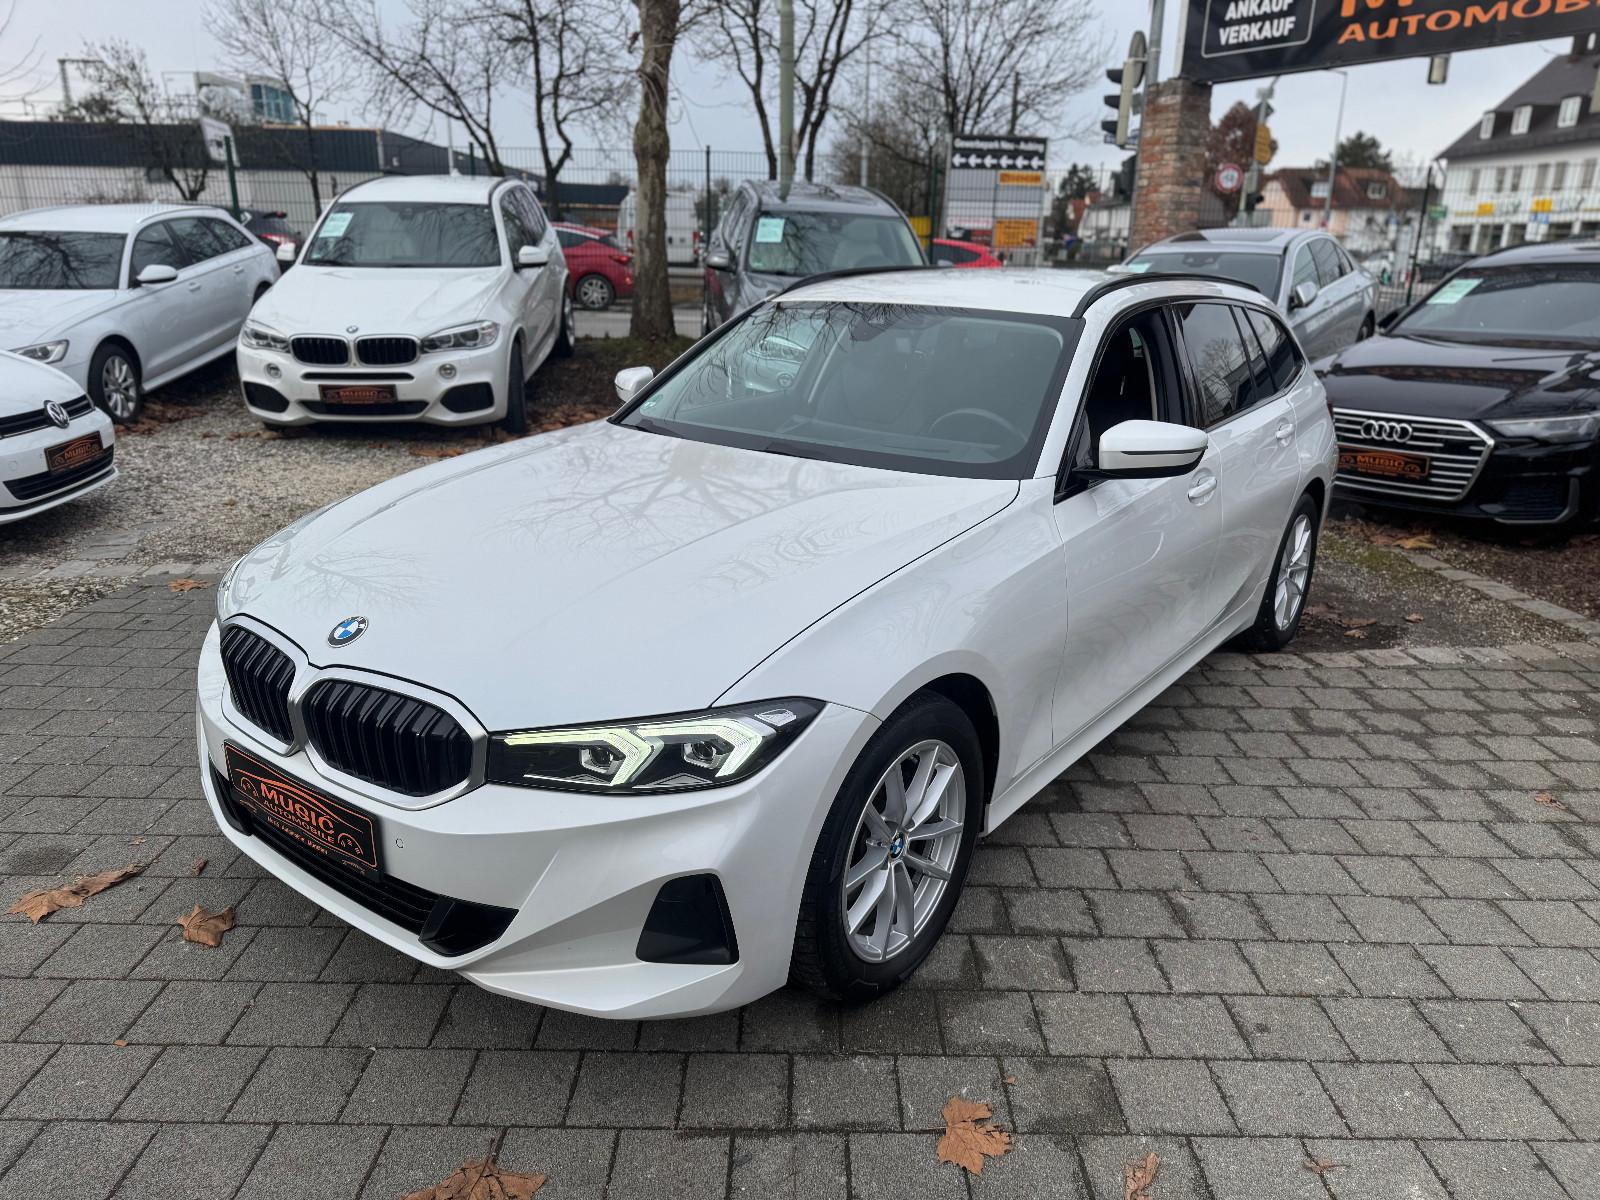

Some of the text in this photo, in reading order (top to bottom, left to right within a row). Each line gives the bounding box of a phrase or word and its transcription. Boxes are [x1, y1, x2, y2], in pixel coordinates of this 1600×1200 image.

[1219, 16, 1296, 45] VERKAUF
[1337, 0, 1600, 44] AUTOMOB
[264, 800, 335, 844] AUTOMOBILE
